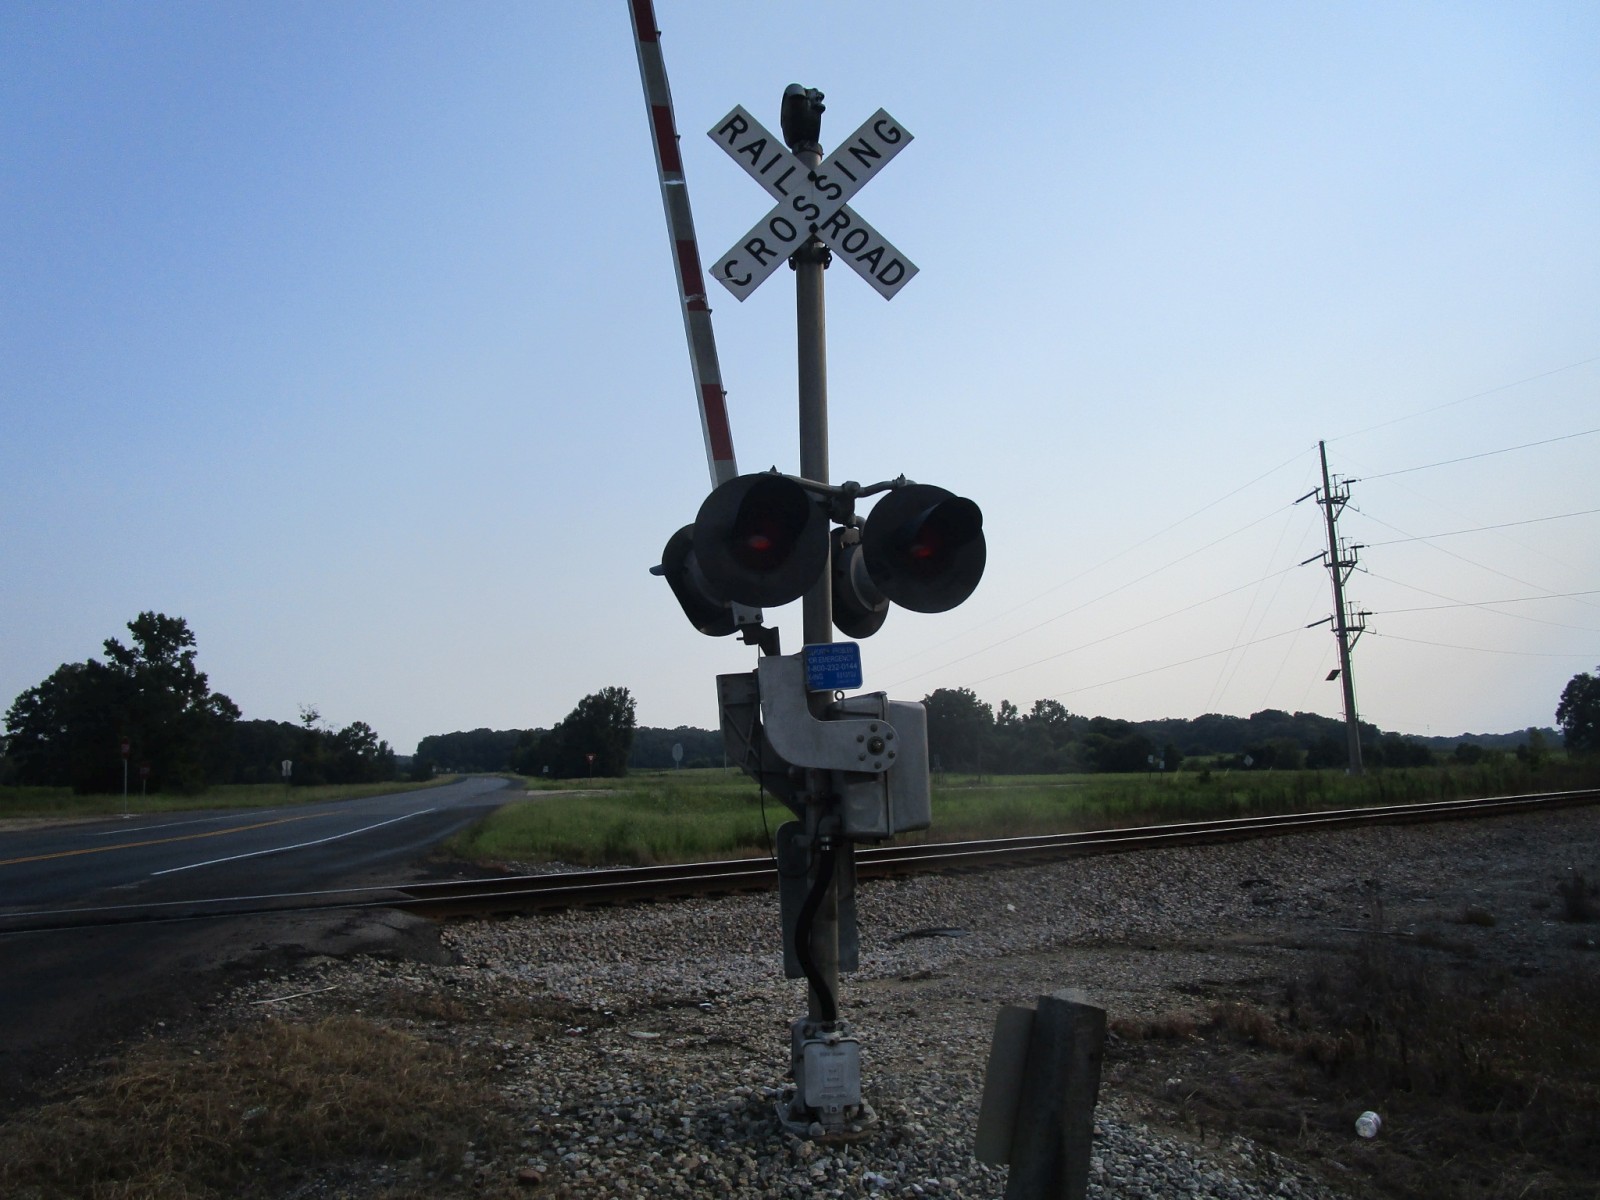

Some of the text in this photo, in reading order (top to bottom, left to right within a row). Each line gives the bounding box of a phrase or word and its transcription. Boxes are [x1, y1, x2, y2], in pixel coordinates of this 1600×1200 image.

[718, 114, 796, 196] RAIL
[724, 119, 902, 287] CROSSING
[820, 209, 905, 286] ROAD
